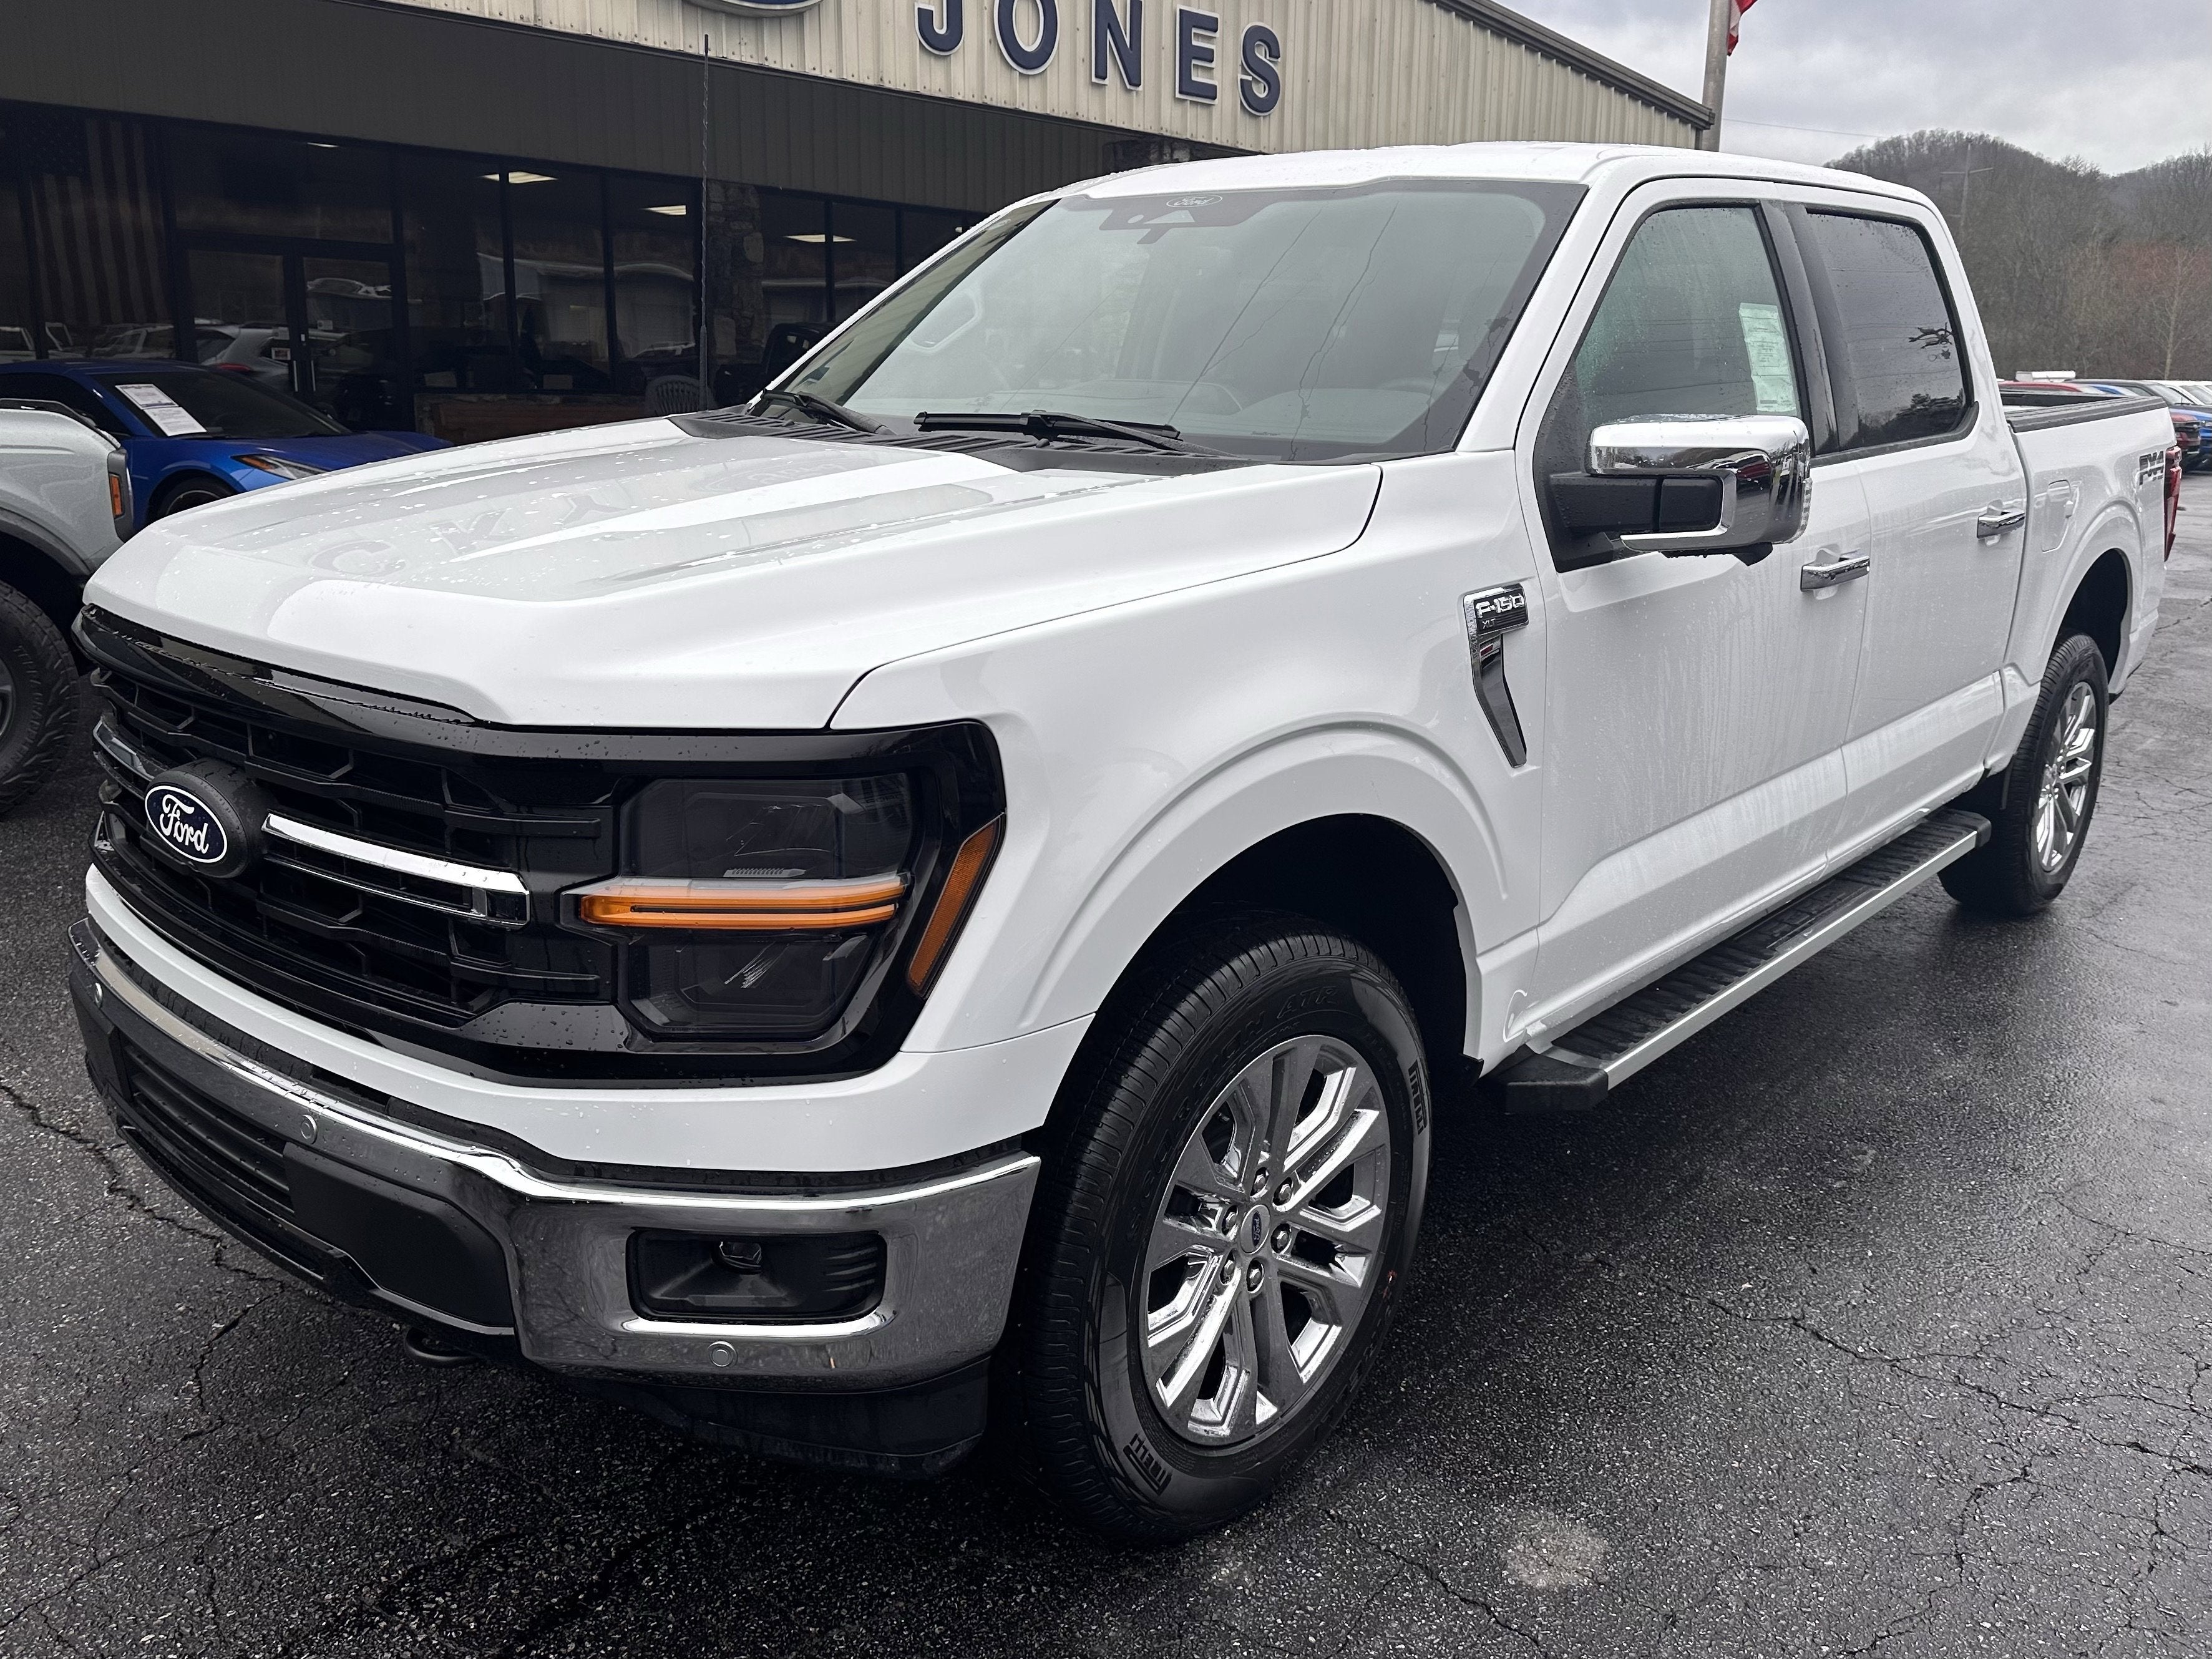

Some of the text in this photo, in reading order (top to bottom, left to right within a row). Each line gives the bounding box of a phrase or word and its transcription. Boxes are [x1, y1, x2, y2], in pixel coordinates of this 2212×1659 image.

[915, 0, 1281, 117] JONES
[1476, 594, 1524, 618] F-150
[1482, 618, 1496, 630] XLT
[160, 794, 209, 854] Ford
[1277, 985, 1339, 1018] ATR
[1408, 1059, 1428, 1136] PIRELLI
[1123, 1433, 1172, 1496] PIRELLI
